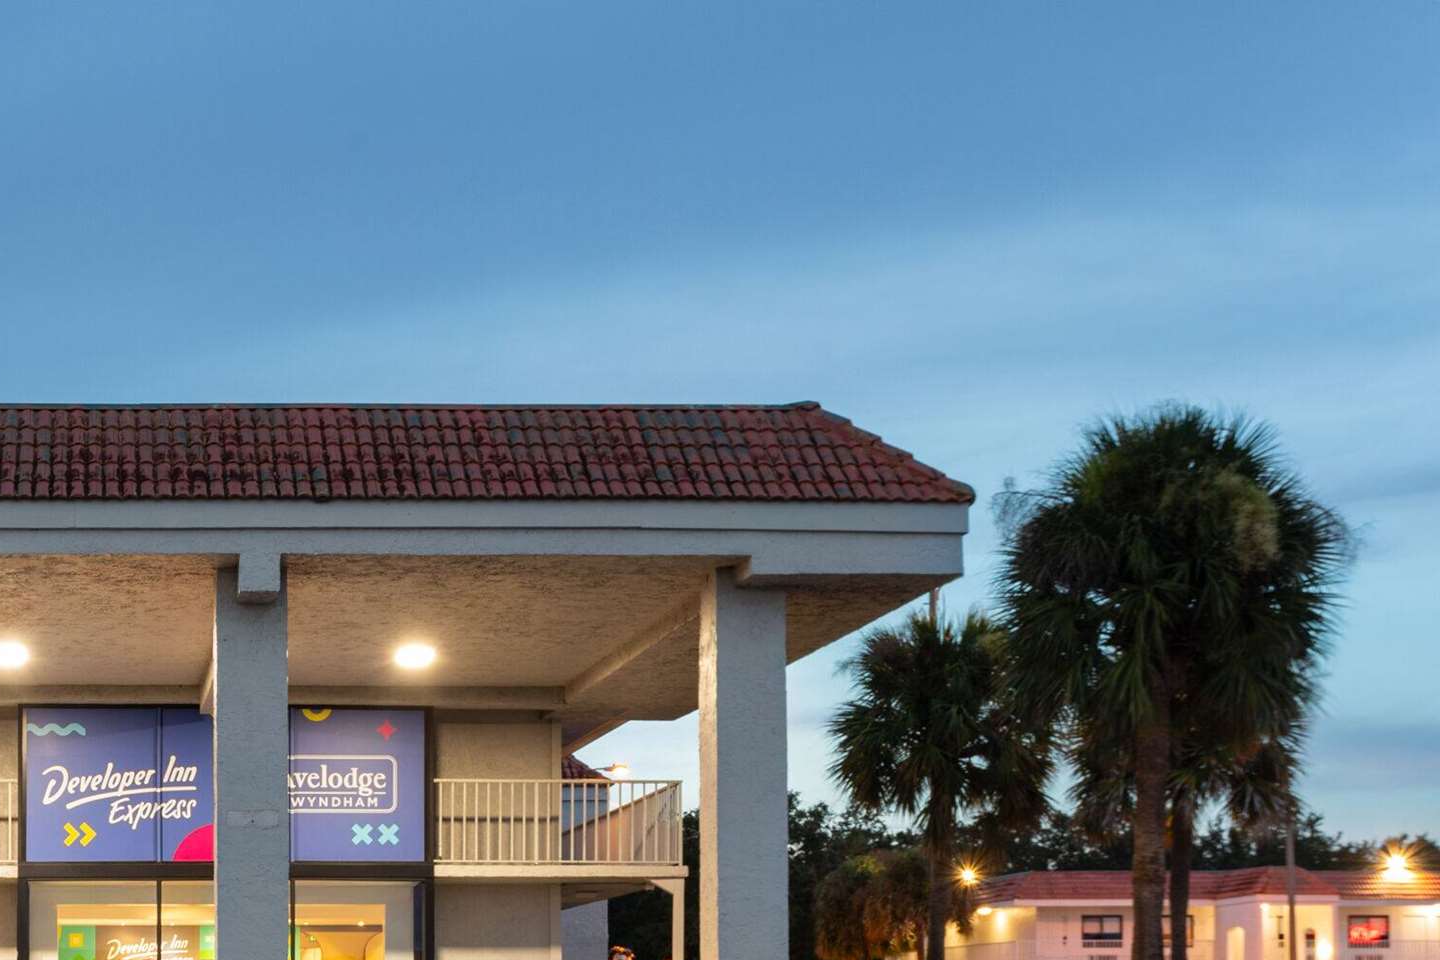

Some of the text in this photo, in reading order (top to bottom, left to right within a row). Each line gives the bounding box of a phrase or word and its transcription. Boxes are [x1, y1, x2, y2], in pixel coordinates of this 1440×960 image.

[41, 755, 197, 805] Developer Inn
[108, 797, 197, 830] Express
[290, 797, 378, 807] WYNDHAM
